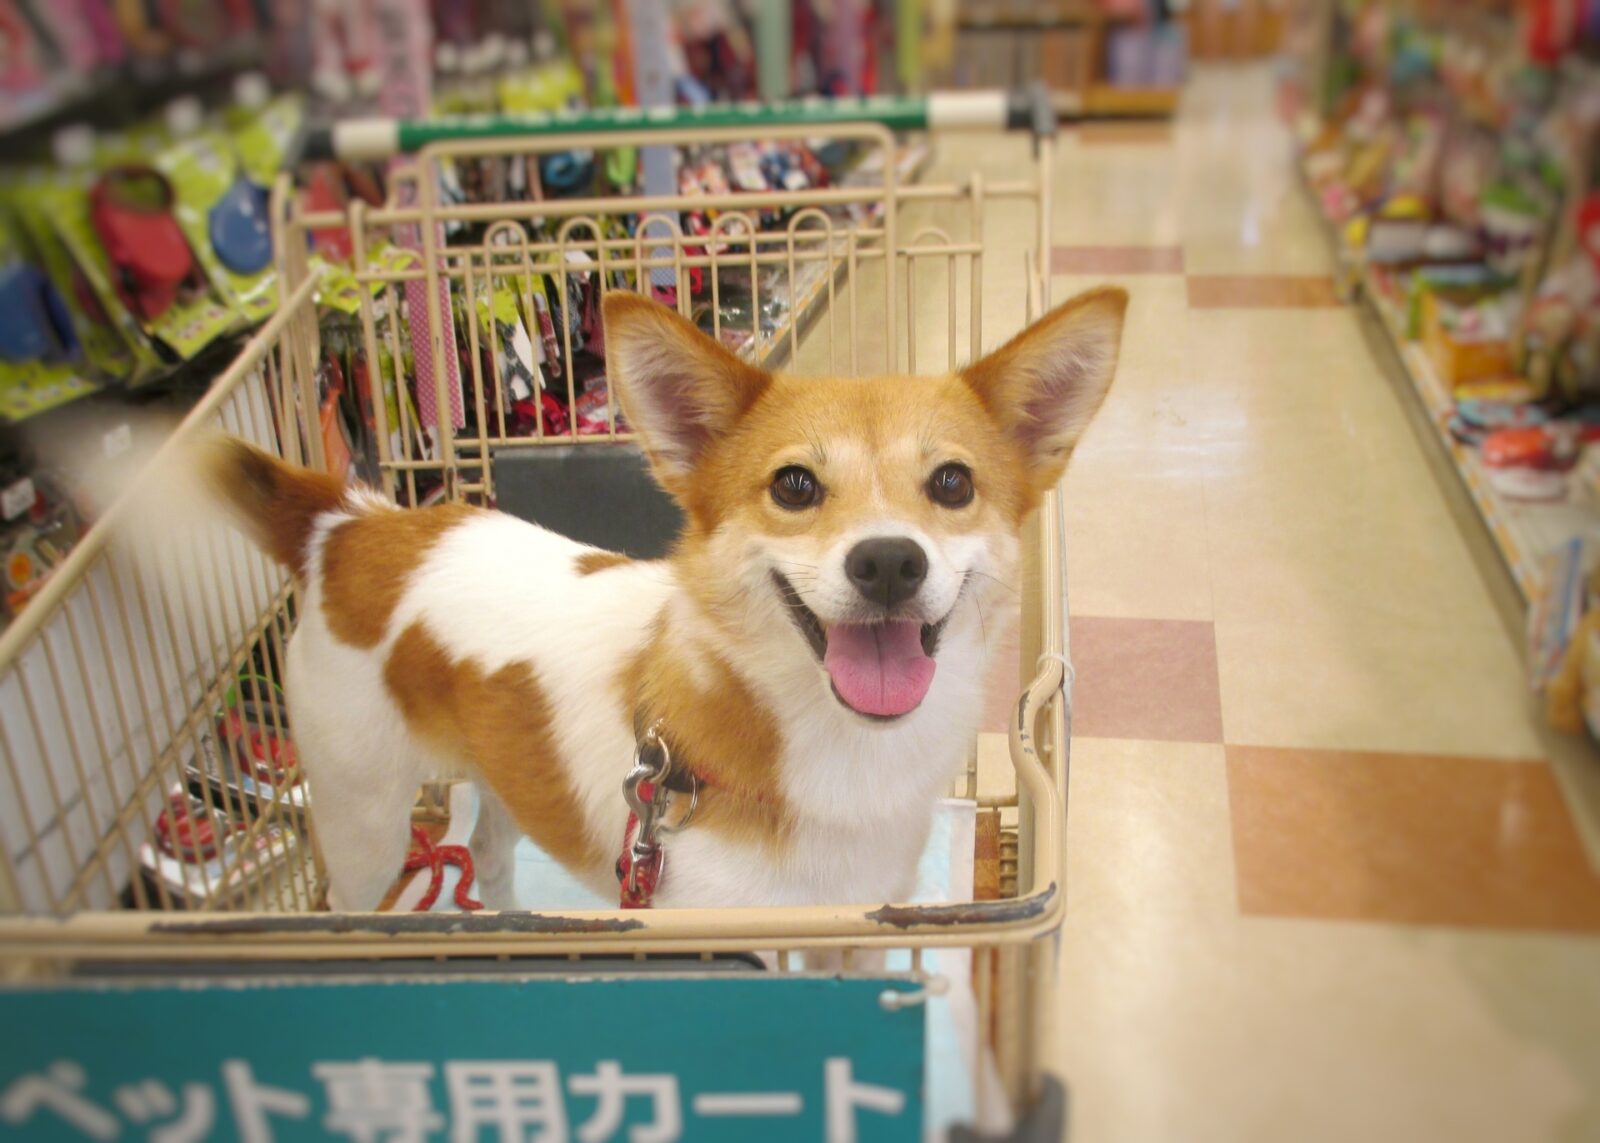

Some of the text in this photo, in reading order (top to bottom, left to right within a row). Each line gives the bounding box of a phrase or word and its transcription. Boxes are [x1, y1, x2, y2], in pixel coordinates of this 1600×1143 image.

[1, 1058, 904, 1143] ペット専用カート
